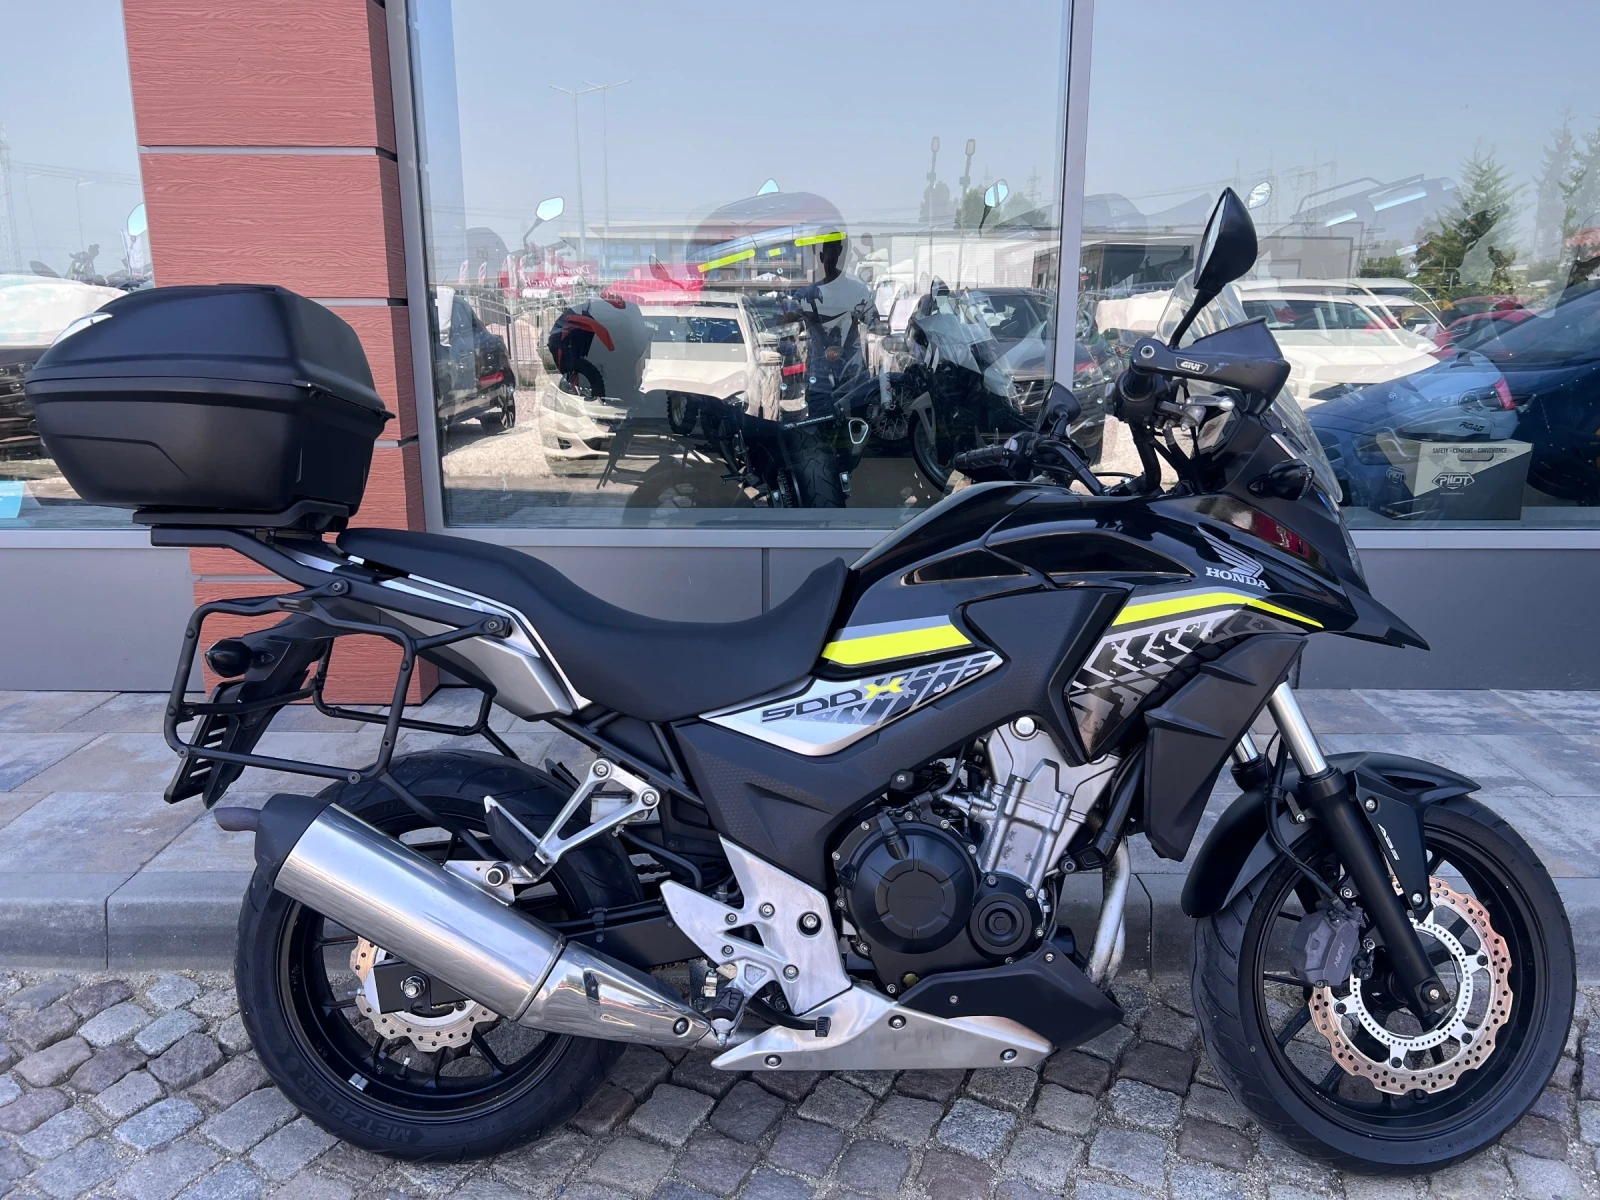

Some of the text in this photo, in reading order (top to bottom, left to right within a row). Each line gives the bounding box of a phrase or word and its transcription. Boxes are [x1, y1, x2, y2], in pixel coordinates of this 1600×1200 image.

[1180, 361, 1201, 371] GIVI
[1458, 421, 1485, 432] ROAD
[1205, 567, 1271, 590] HONDA
[761, 677, 904, 723] 500X
[296, 1072, 412, 1143] METZELER
